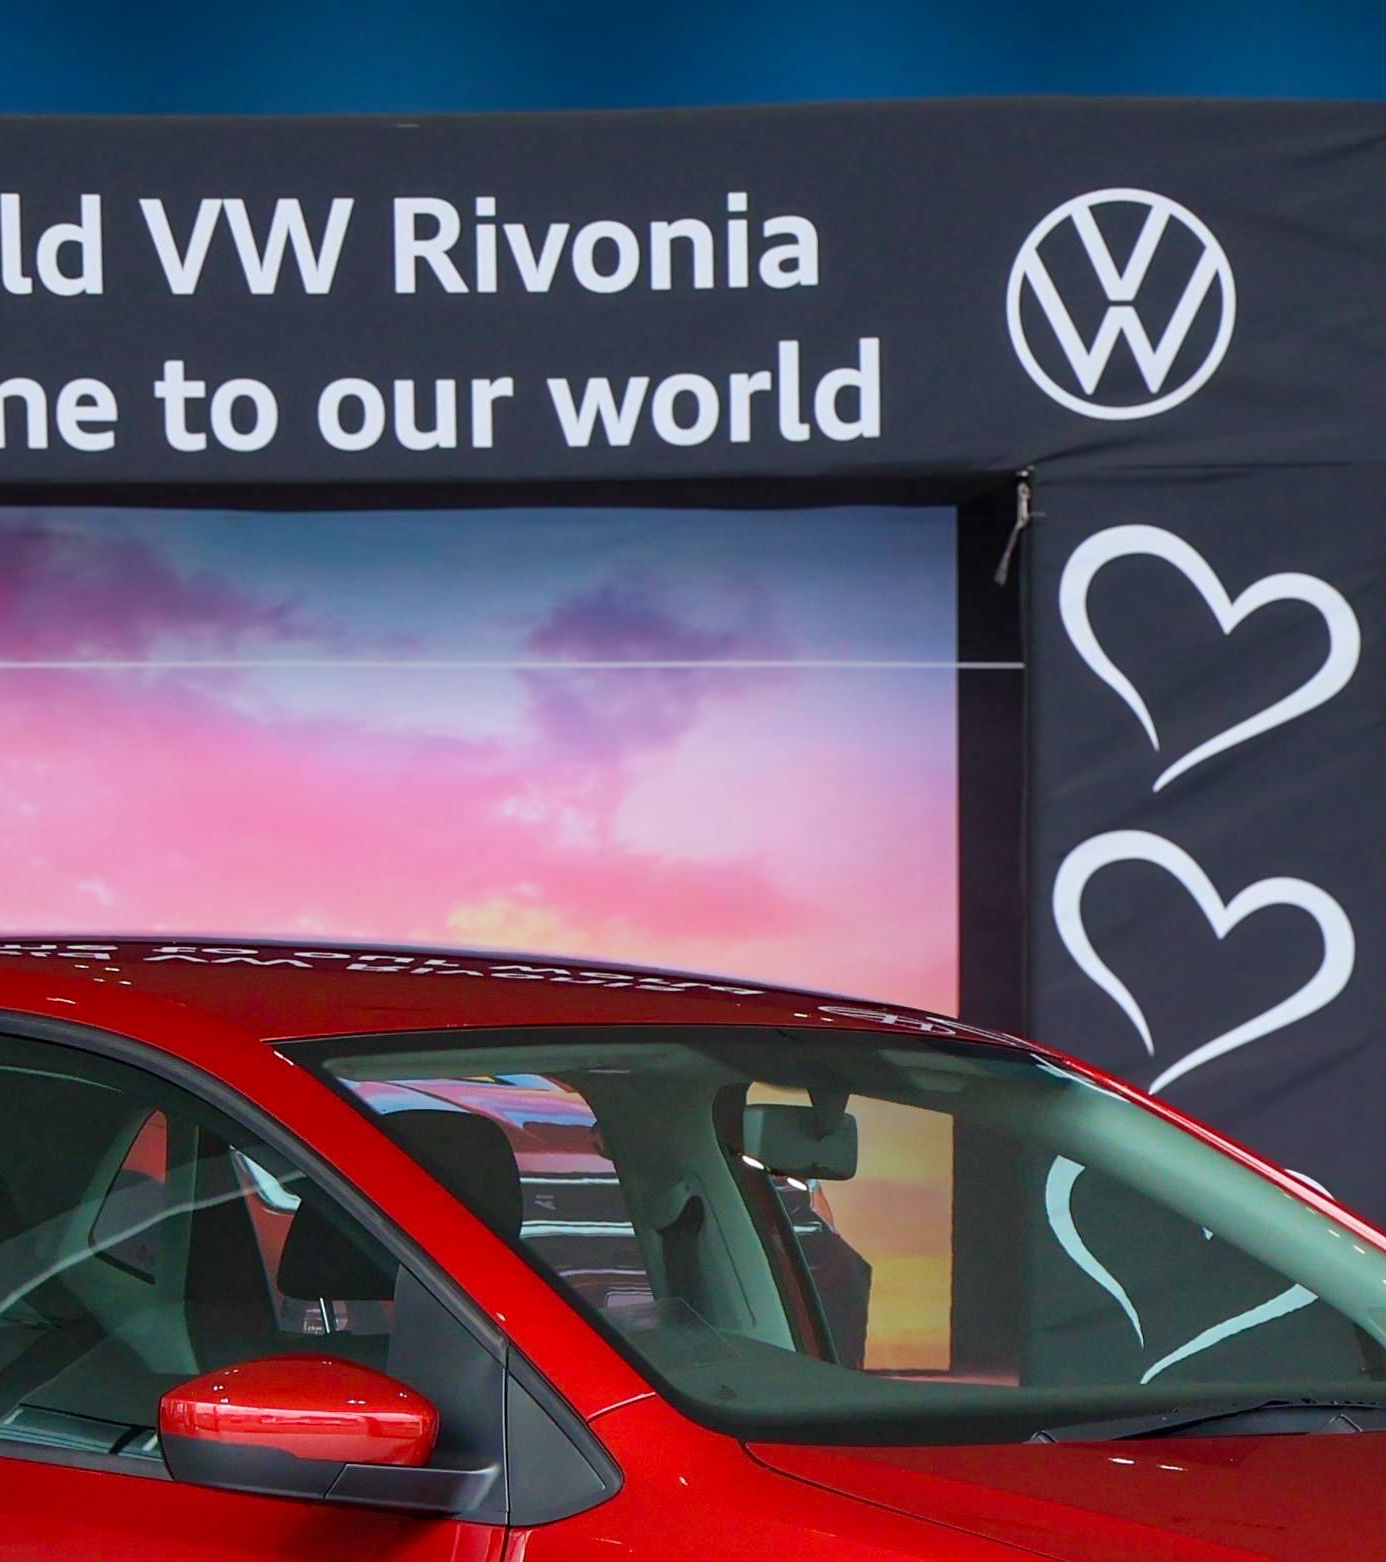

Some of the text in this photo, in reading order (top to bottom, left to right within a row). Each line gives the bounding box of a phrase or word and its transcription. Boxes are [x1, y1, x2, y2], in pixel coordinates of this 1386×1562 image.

[139, 197, 355, 294] VW
[393, 191, 819, 294] Rivonia
[154, 360, 278, 452] to
[317, 376, 514, 451] our
[546, 337, 881, 447] world
